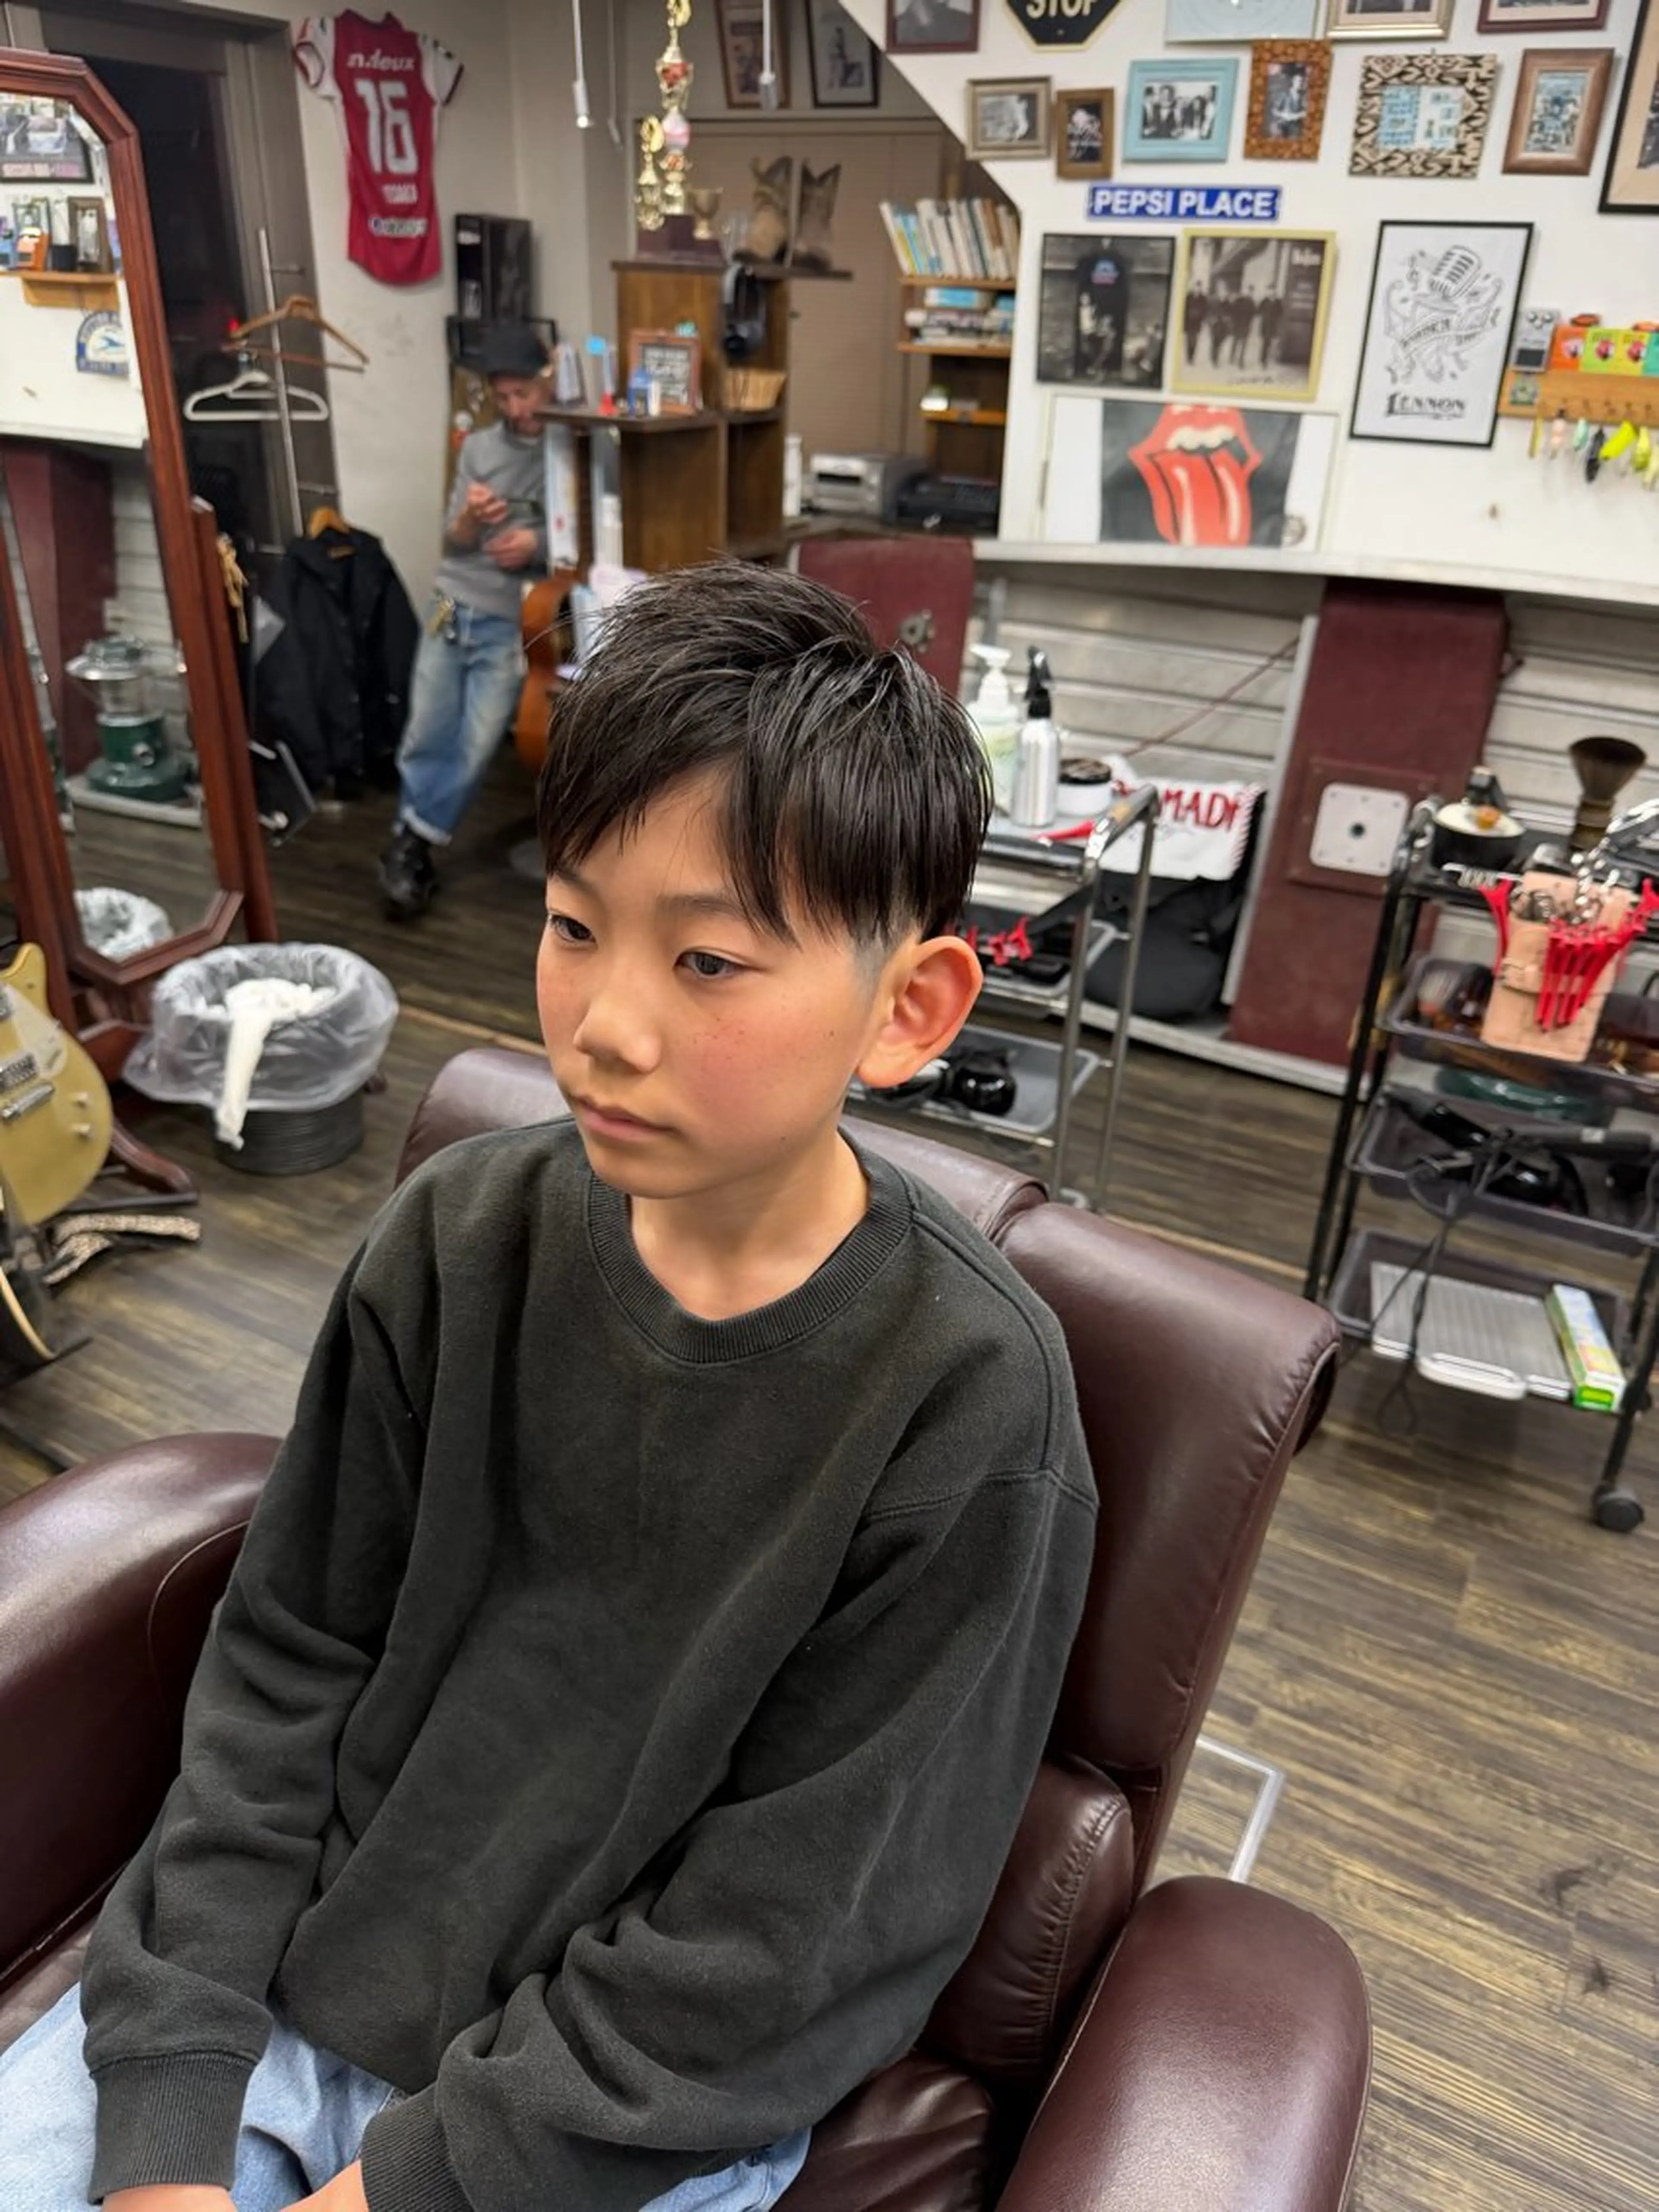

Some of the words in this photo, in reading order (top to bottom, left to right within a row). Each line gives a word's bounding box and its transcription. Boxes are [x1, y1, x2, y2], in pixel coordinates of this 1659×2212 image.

[354, 77, 420, 174] 16
[1093, 188, 1174, 216] PEPSI
[1178, 189, 1275, 217] PLACE
